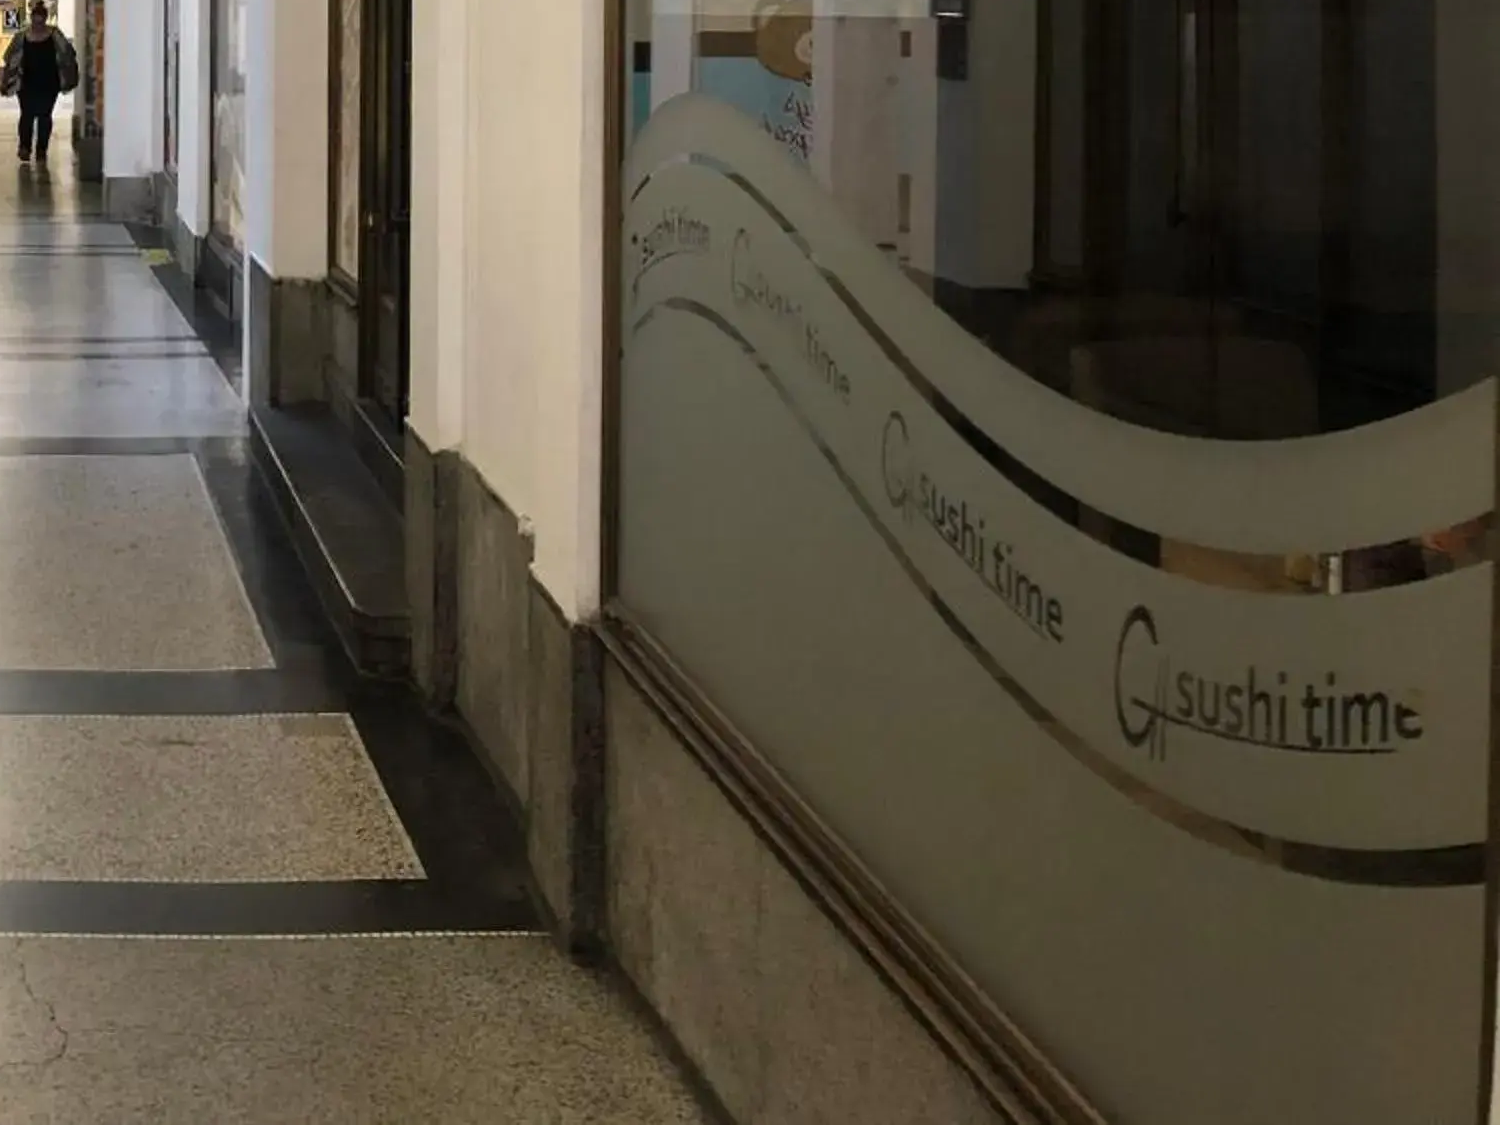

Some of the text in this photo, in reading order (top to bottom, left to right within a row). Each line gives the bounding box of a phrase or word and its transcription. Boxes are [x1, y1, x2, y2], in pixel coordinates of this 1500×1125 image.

[919, 472, 985, 574] sushi
[993, 540, 1065, 644] time
[1175, 665, 1288, 746] sushi
[1300, 671, 1424, 748] time
